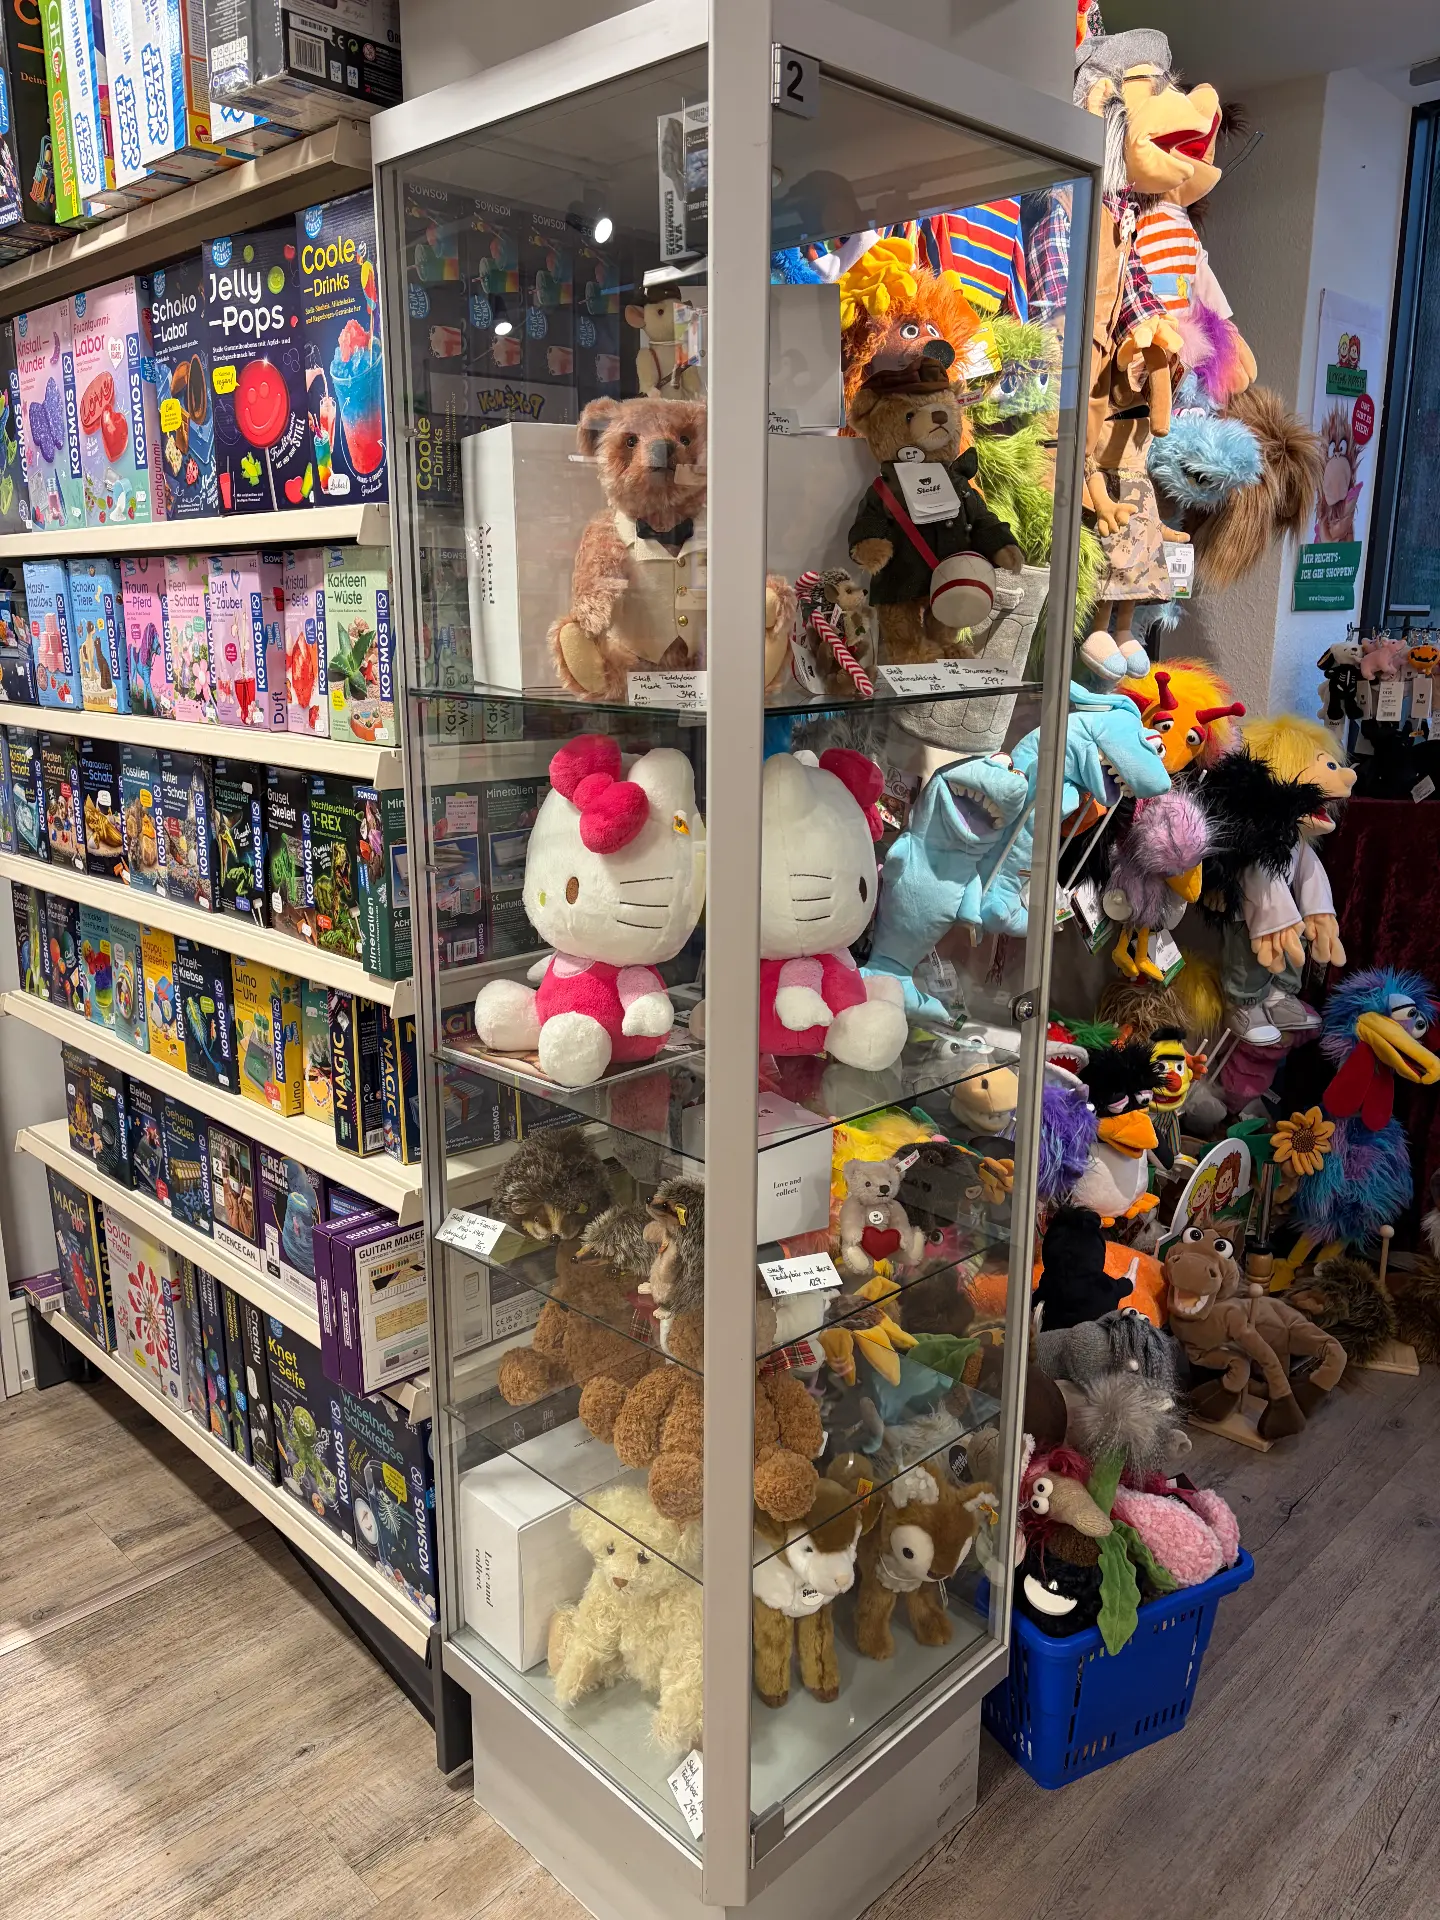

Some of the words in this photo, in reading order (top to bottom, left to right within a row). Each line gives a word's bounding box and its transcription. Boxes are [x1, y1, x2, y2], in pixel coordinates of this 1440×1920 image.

[77, 70, 88, 97] DAS
[787, 61, 803, 102] 2
[52, 90, 73, 197] Chemie
[409, 183, 448, 201] KOSMOS
[475, 199, 511, 217] KOSMOS
[533, 214, 566, 231] KOSMOS
[302, 236, 355, 274] Coole
[210, 268, 261, 304] Jelly
[304, 274, 349, 298] -Drinks
[410, 293, 418, 310] FUN
[152, 294, 197, 323] Schoko
[209, 305, 284, 338] -Pops
[473, 304, 481, 322] FUN
[75, 335, 105, 357] Labor
[154, 322, 188, 342] -Labor
[19, 355, 46, 374] Wunder
[66, 388, 82, 476] KOSMOS
[129, 373, 147, 465] KOSMOS
[15, 403, 29, 483] KOSMOS
[416, 417, 432, 491] Coole
[434, 428, 444, 491] -Drinks
[156, 440, 165, 516] Fruchtgummi-
[917, 484, 941, 494] Steiff
[1301, 570, 1311, 579] ICH
[1303, 554, 1314, 564] MIR
[125, 581, 149, 594] Traum
[168, 580, 187, 592] Feen
[211, 581, 228, 597] Duft
[285, 574, 308, 590] Kristall
[328, 573, 367, 588] Kakteen
[126, 596, 152, 608] -Pferd
[170, 595, 200, 607] -Schatz
[212, 599, 243, 609] -Zauber
[328, 591, 363, 605] -Wüste
[60, 617, 72, 674] KOSMOS
[107, 618, 120, 677] KOSMOS
[163, 619, 174, 681] KOSMOS
[254, 621, 266, 689] KOSMOS
[317, 620, 326, 691] KOSMOS
[379, 622, 391, 698] KOSMOS
[274, 691, 285, 724] Duft
[10, 763, 30, 776] Schatz
[122, 764, 150, 780] Fossilien
[37, 780, 46, 831] KOSMOS
[163, 787, 187, 800] -Schatz
[267, 788, 289, 805] Grusel
[486, 786, 534, 799] Mineralien
[73, 789, 83, 842] KOSMOS
[268, 806, 297, 821] -Skelett
[313, 812, 342, 833] T-REX
[155, 807, 166, 865] KOSMOS
[197, 816, 208, 876] KOSMOS
[254, 826, 263, 888] KOSMOS
[306, 839, 314, 905] KOSMOS
[13, 890, 32, 902] Space-
[369, 897, 378, 970] Mineralien
[42, 927, 50, 973] KOSMOS
[177, 953, 202, 968] Urzeit-
[179, 966, 204, 983] Krebse
[235, 968, 257, 988] Limo
[174, 984, 185, 1039] KOSMOS
[218, 1001, 230, 1058] KOSMOS
[274, 1021, 284, 1080] KOSMOS
[333, 1031, 347, 1111] MAGIC
[383, 1037, 396, 1117] MAGIC
[130, 1083, 152, 1102] Elektro
[293, 1081, 301, 1110] Limo
[165, 1106, 193, 1128] Geheim
[166, 1120, 196, 1142] -Codes
[492, 1105, 500, 1143] KOSMOS
[118, 1112, 128, 1160] KOSMOS
[201, 1155, 211, 1205] KOSMOS
[215, 1161, 220, 1171] 2
[262, 1168, 275, 1181] blue
[275, 1175, 289, 1189] hole
[773, 1179, 789, 1190] Love
[789, 1176, 802, 1185] and
[776, 1186, 799, 1198] collect.
[52, 1188, 86, 1223] MAGIC
[106, 1217, 131, 1249] Solar
[217, 1231, 242, 1251] SCIENCE
[242, 1246, 257, 1262] CAN.
[107, 1237, 132, 1261] -Flower
[270, 1242, 275, 1256] 1
[359, 1240, 392, 1259] GUITAR
[162, 1304, 179, 1371] KOSMOS
[251, 1309, 261, 1365] Crashy
[267, 1336, 298, 1370] Knet
[270, 1359, 306, 1391] -Seife
[342, 1392, 395, 1441] Wuselnde
[343, 1407, 405, 1465] Salzkrebse
[335, 1428, 350, 1504] KOSMOS
[420, 1495, 431, 1575] KOSMOS
[474, 1547, 484, 1591] collect.
[483, 1550, 492, 1583] Love
[484, 1584, 494, 1609] and
